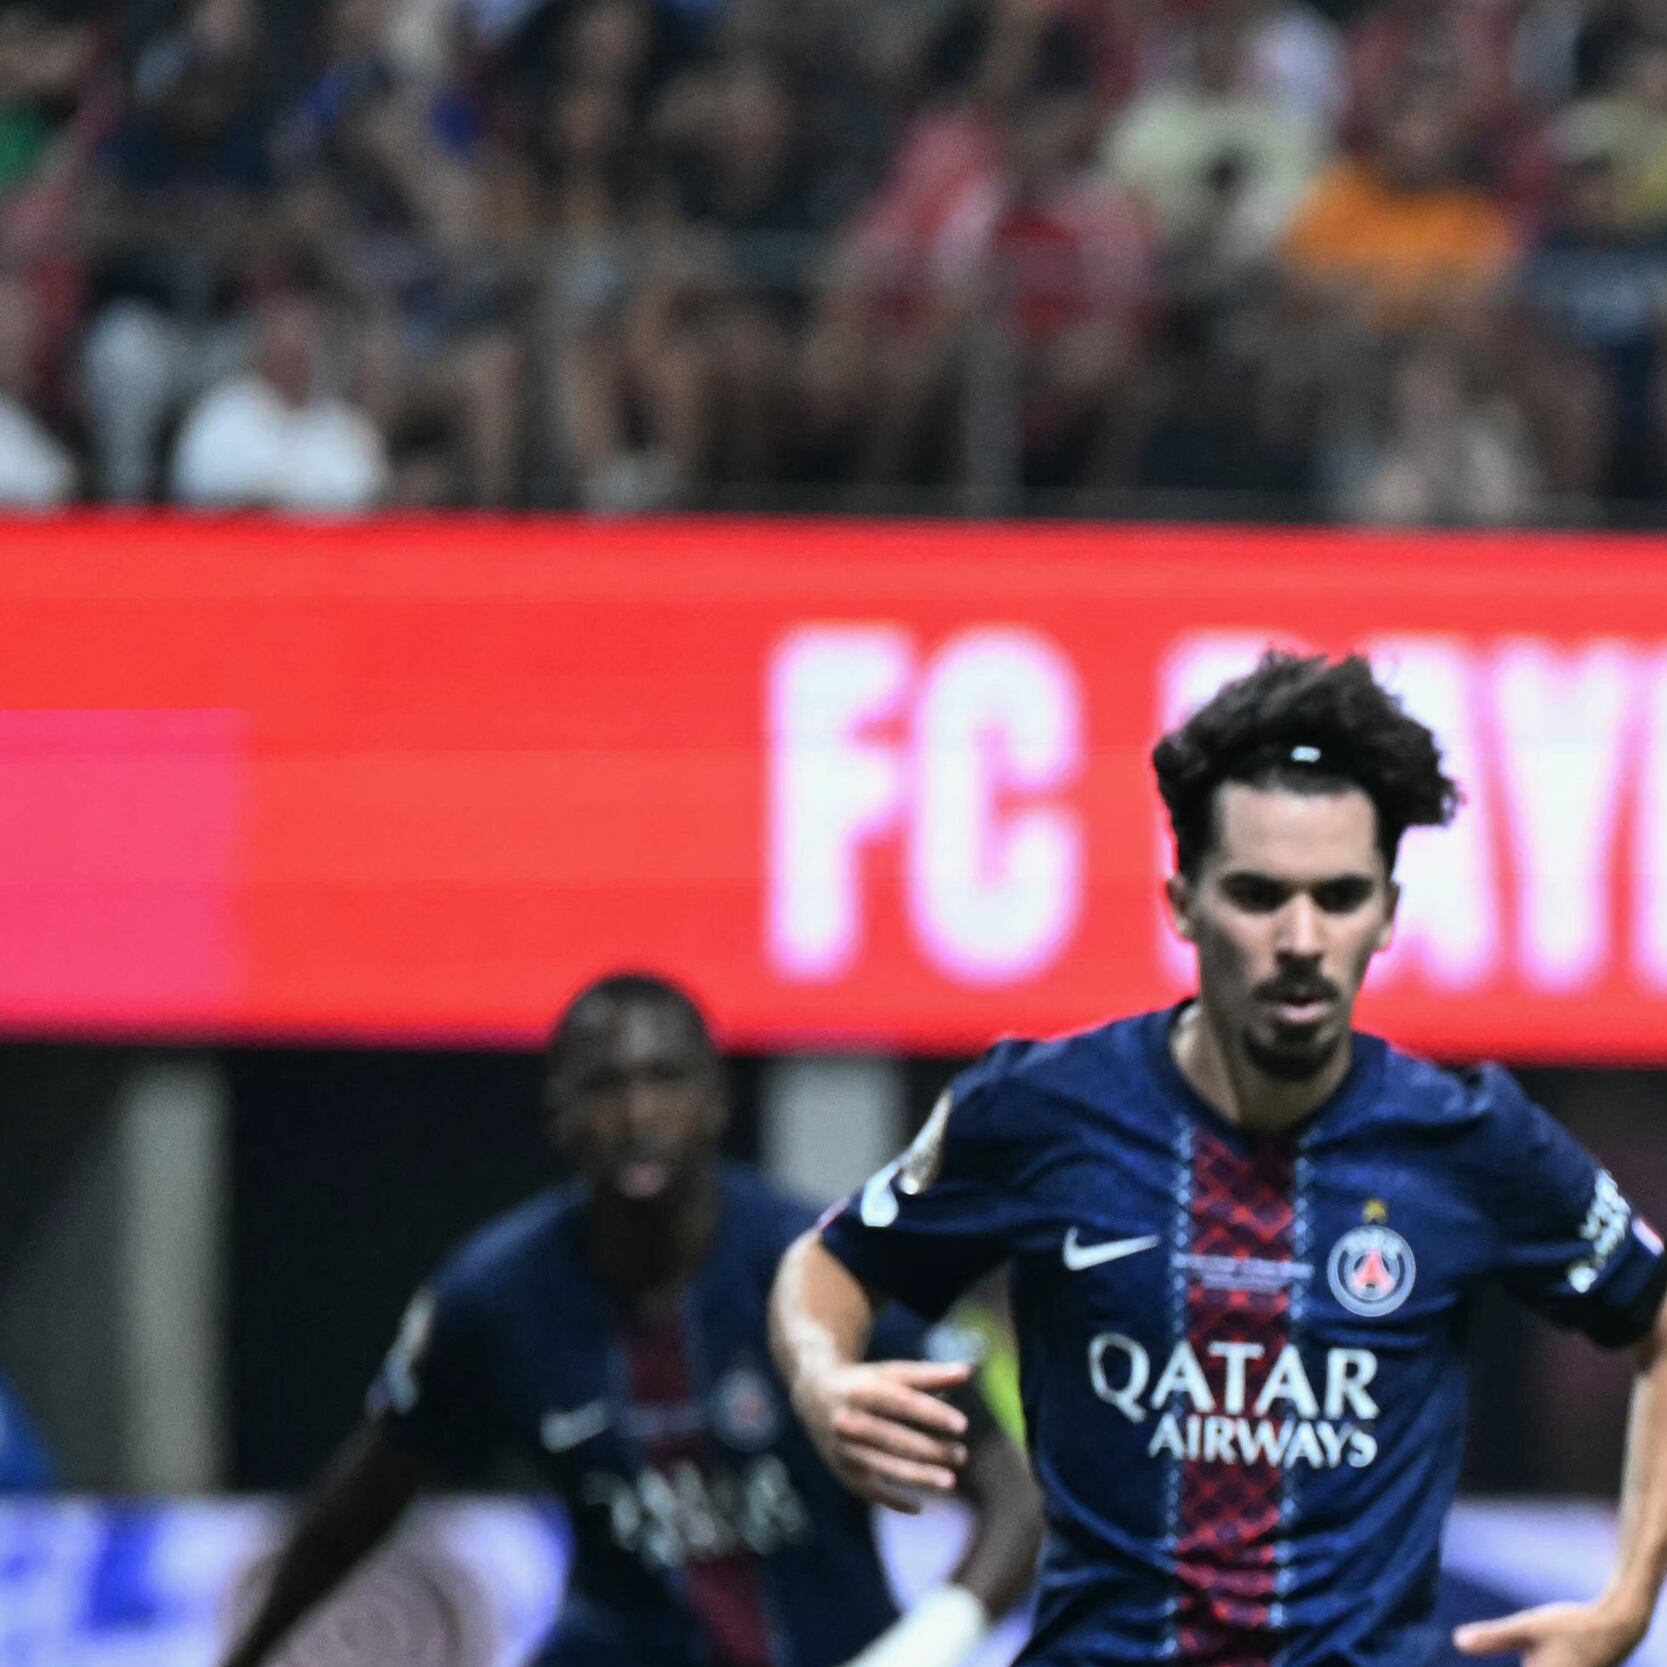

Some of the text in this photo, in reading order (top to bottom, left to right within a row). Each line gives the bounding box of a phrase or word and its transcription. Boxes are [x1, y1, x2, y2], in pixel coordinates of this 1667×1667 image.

[772, 630, 1078, 980] FC
[1087, 1332, 1378, 1423] QATAR
[1147, 1414, 1378, 1469] AIRWAYS
